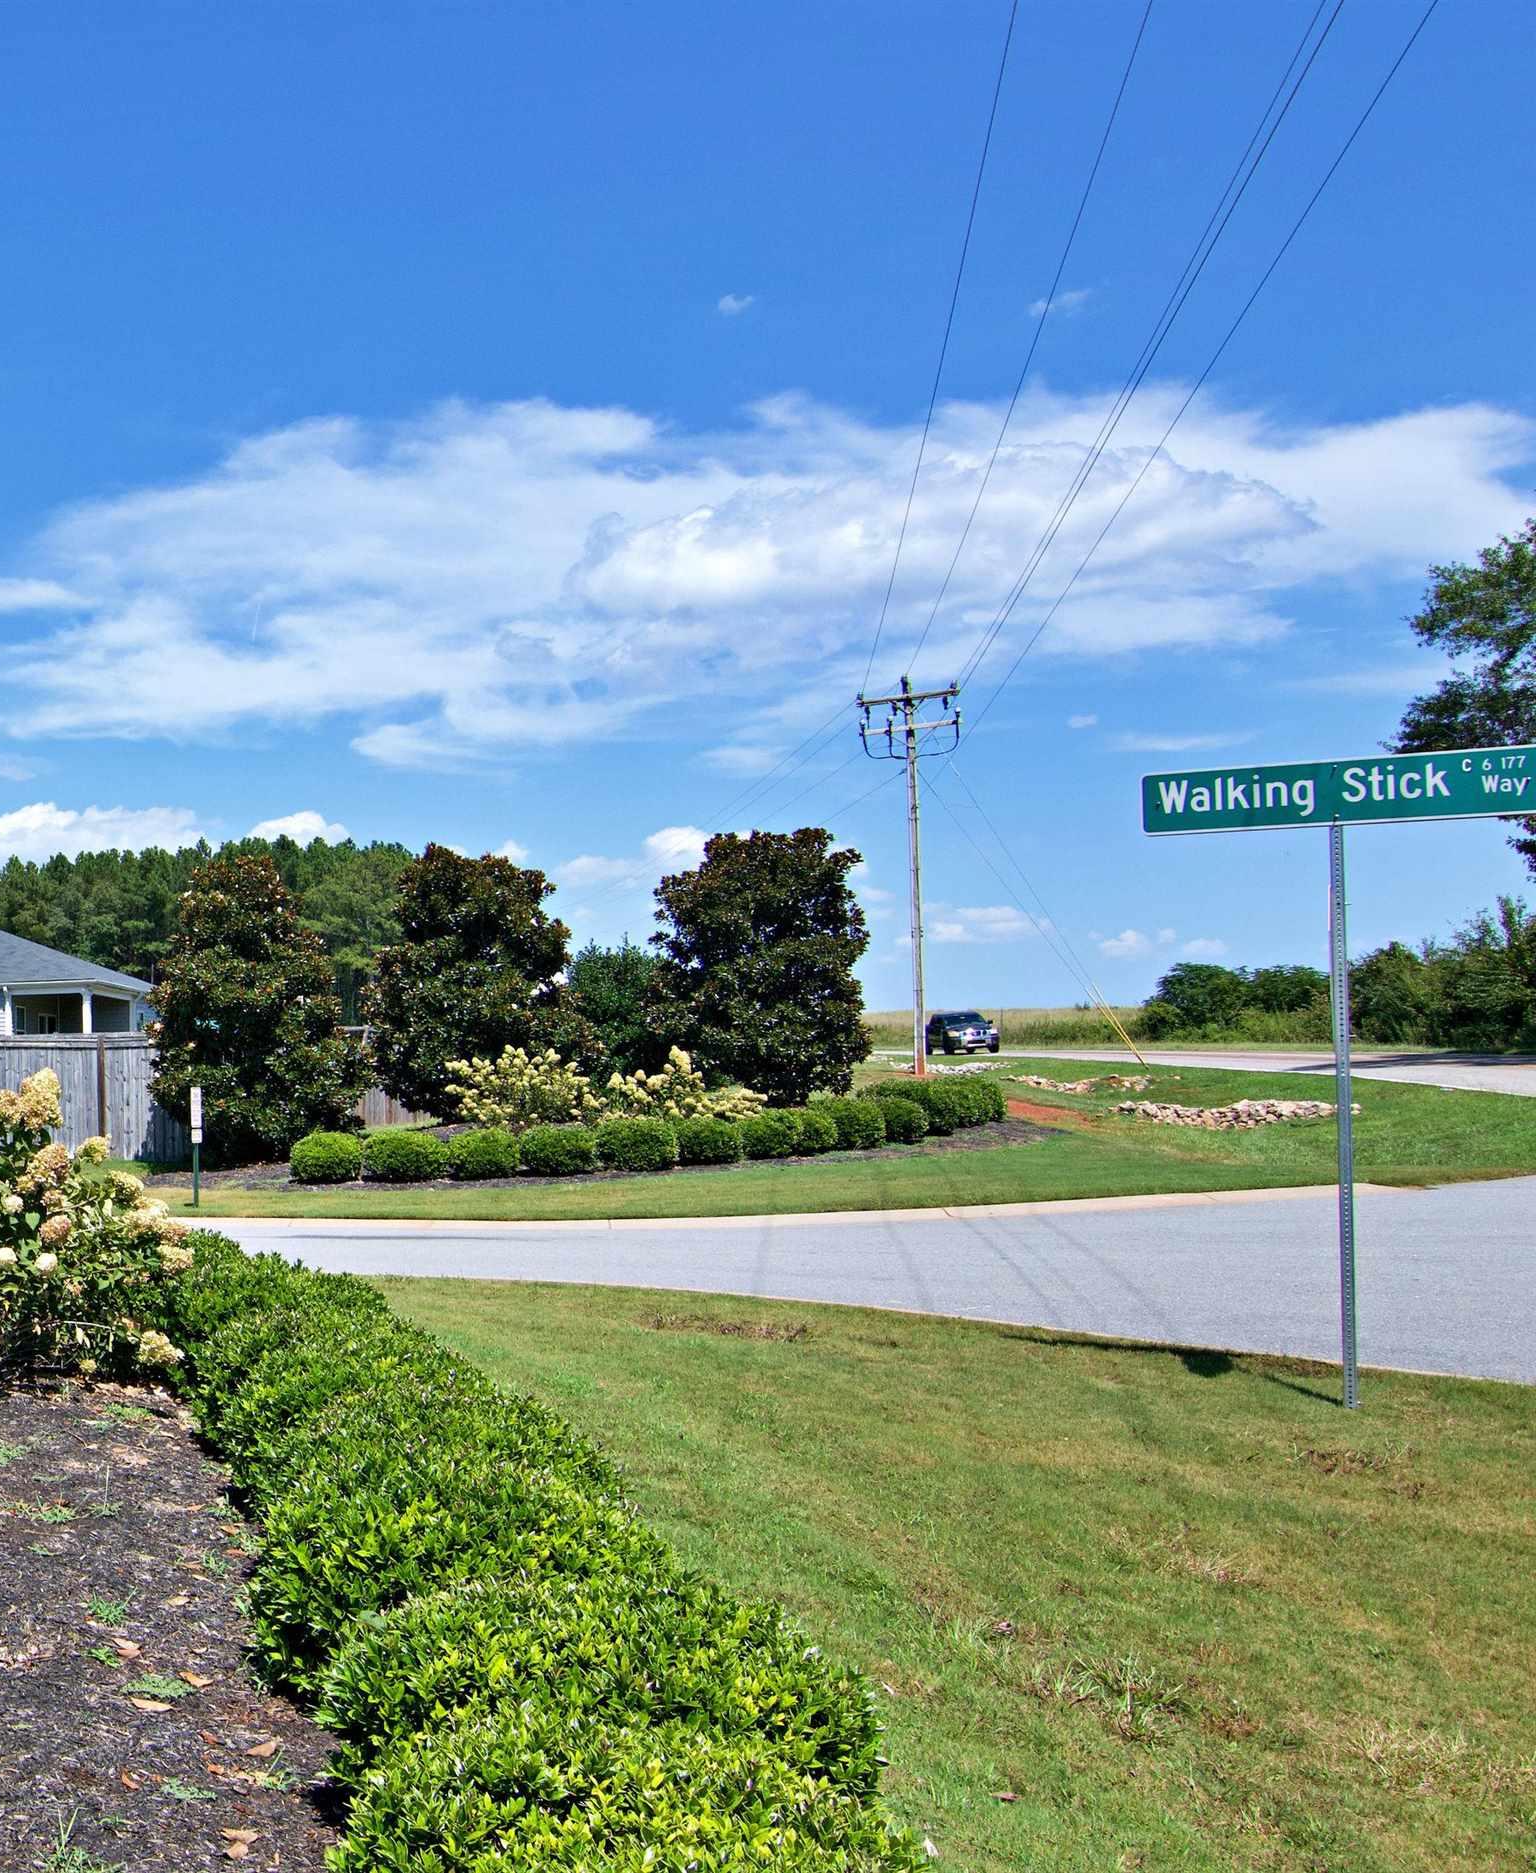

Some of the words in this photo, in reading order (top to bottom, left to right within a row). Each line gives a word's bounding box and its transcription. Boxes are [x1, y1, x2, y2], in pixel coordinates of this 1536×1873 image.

[1461, 758, 1472, 773] C
[1481, 758, 1492, 771] 6
[1500, 755, 1526, 770] 177
[1158, 774, 1315, 817] Walking
[1341, 762, 1451, 802] Stick
[1481, 774, 1528, 796] Way
